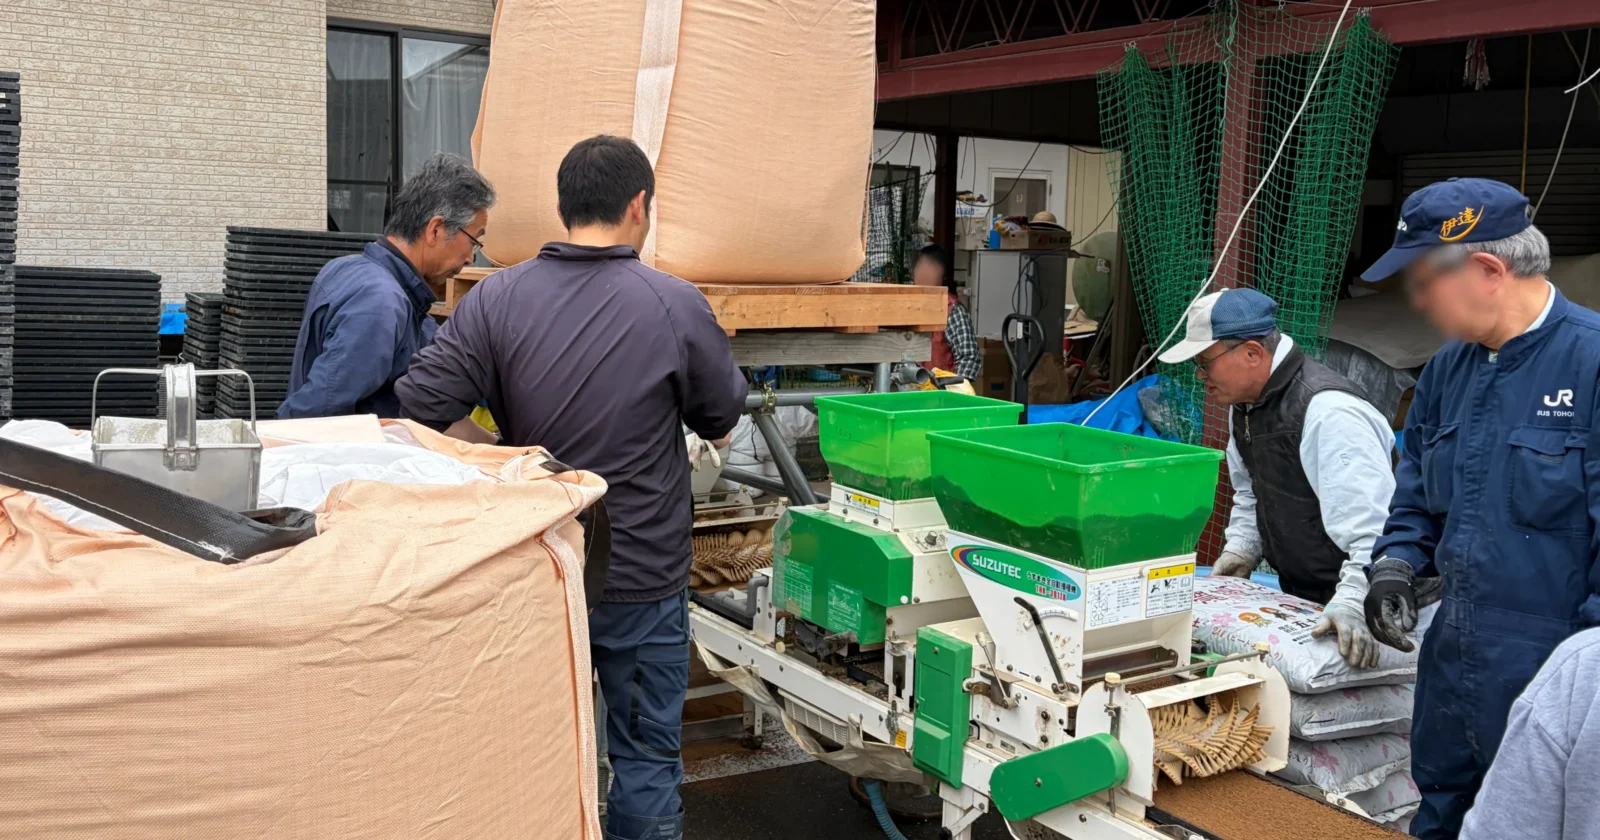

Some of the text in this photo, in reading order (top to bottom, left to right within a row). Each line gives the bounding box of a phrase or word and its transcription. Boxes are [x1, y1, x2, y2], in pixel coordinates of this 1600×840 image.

[1440, 206, 1477, 237] 伊達
[1543, 389, 1573, 407] JR
[972, 553, 1022, 580] SUZUTEC
